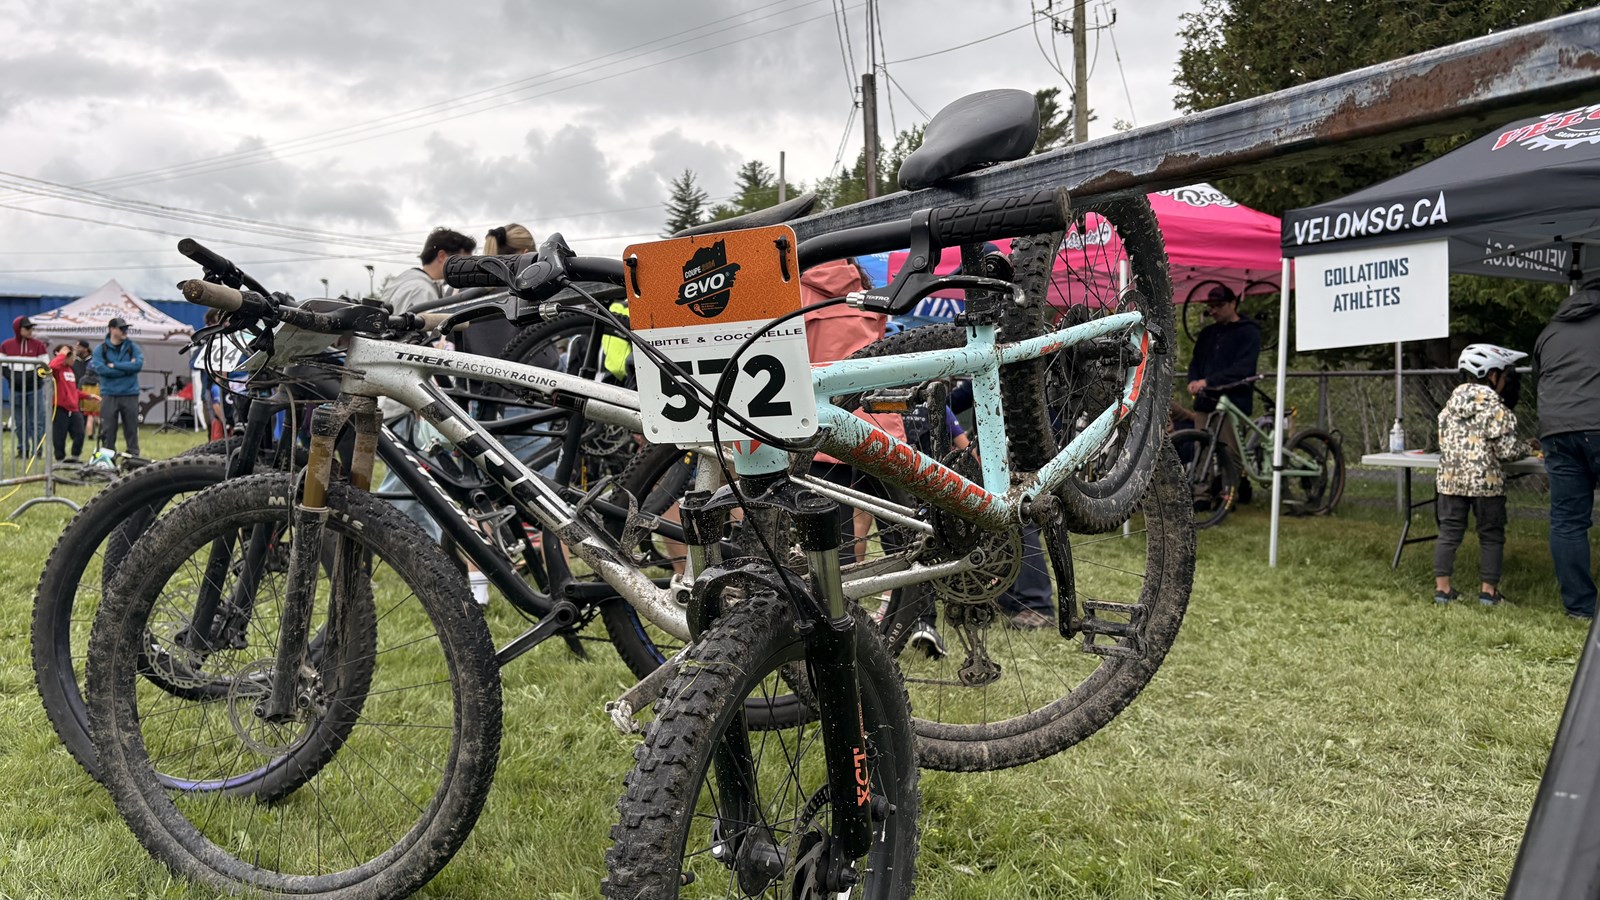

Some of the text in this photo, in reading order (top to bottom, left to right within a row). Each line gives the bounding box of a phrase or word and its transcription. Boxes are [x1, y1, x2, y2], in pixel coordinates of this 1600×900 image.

[1293, 190, 1448, 246] VELOMSG.CA
[684, 265, 702, 279] COUPE
[1324, 257, 1409, 287] COLLATIONS
[684, 273, 725, 299] evo
[1332, 284, 1401, 313] ATHLÈTES
[646, 337, 690, 347] IBITTE
[714, 327, 803, 342] COCCNELLE
[394, 351, 454, 368] TREK
[659, 354, 793, 422] 572
